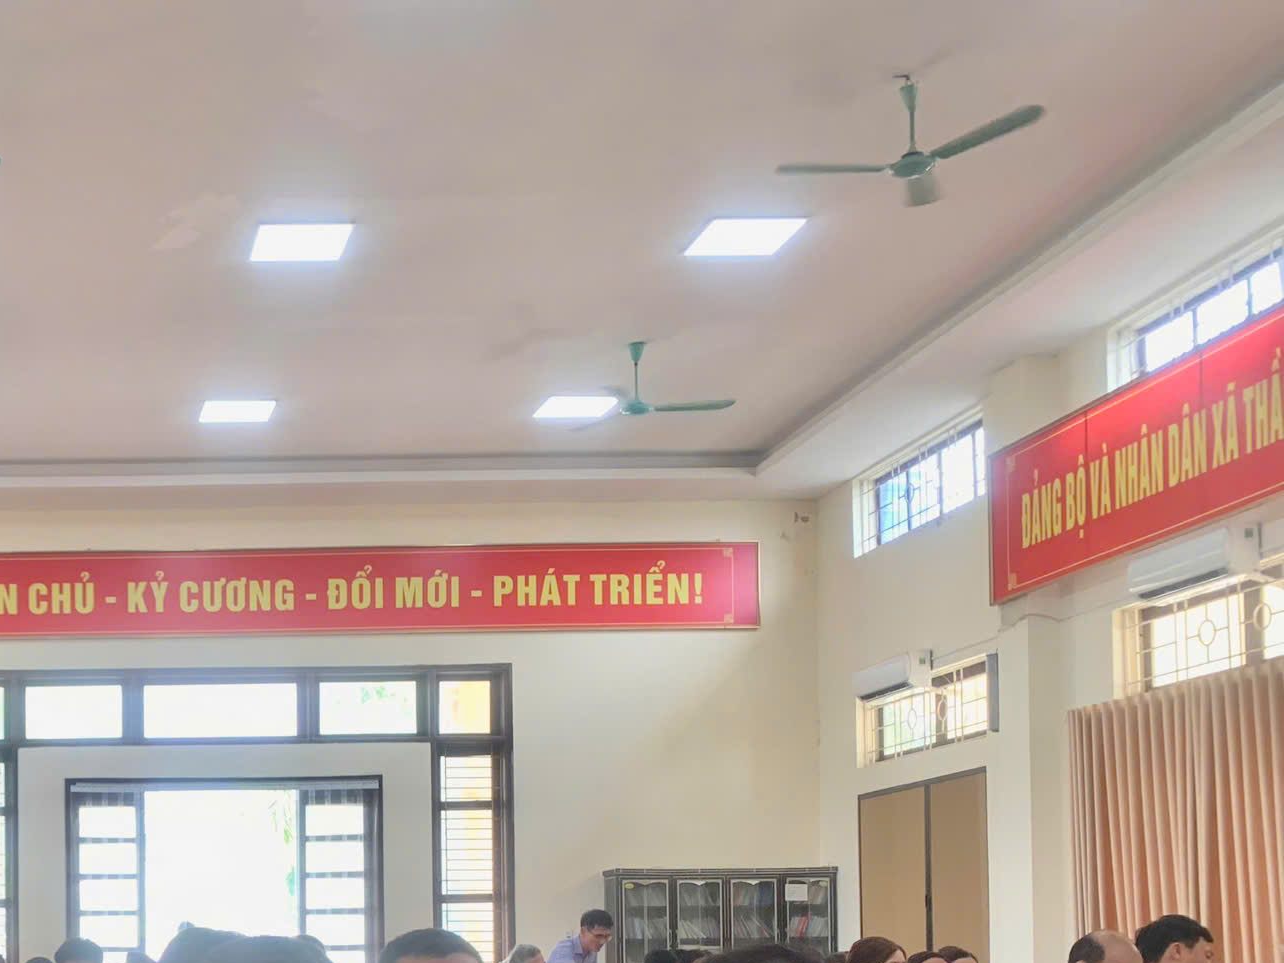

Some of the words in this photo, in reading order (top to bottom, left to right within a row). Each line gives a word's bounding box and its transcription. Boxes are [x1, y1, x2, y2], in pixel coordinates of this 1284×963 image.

[1021, 469, 1062, 549] ĐẢNG
[1066, 454, 1087, 539] BỘ
[1089, 443, 1111, 520] VÀ
[1114, 423, 1164, 510] NHÂN
[1168, 403, 1208, 488] DÂN
[1211, 382, 1239, 469] XÃ
[28, 571, 95, 615] CHỦ
[127, 570, 168, 614] KỶ
[179, 576, 294, 613] CƯƠNG
[326, 564, 384, 610] ĐỔI
[395, 568, 460, 609] MỚI
[494, 567, 581, 608] PHÁT
[589, 560, 704, 606] TRIỂN!
